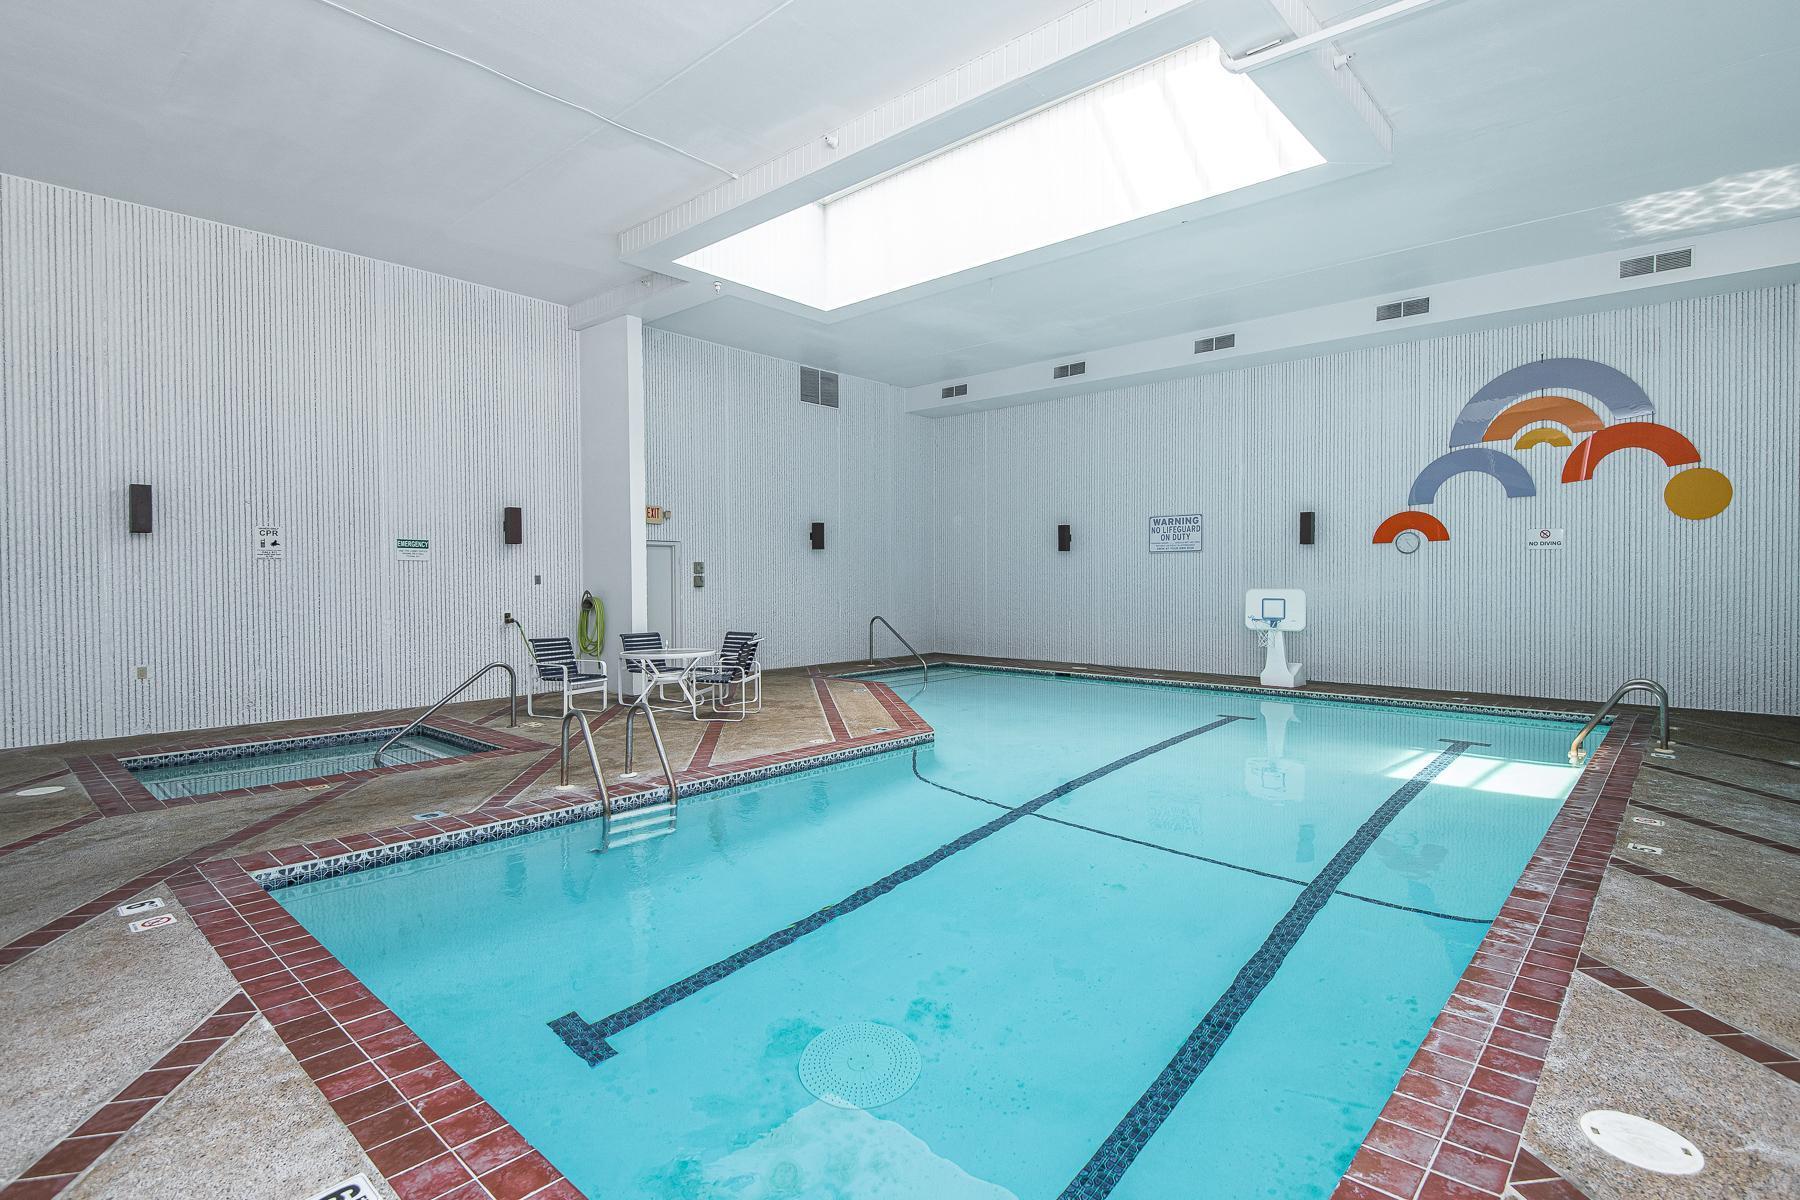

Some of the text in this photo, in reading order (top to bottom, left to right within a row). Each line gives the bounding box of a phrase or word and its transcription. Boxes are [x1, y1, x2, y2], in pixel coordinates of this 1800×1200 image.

[646, 507, 659, 519] EXIT
[1153, 517, 1199, 526] WARNING
[1162, 525, 1201, 534] LIFEGUARD
[1172, 533, 1191, 541] DUTY
[398, 540, 428, 548] EMERGENCY
